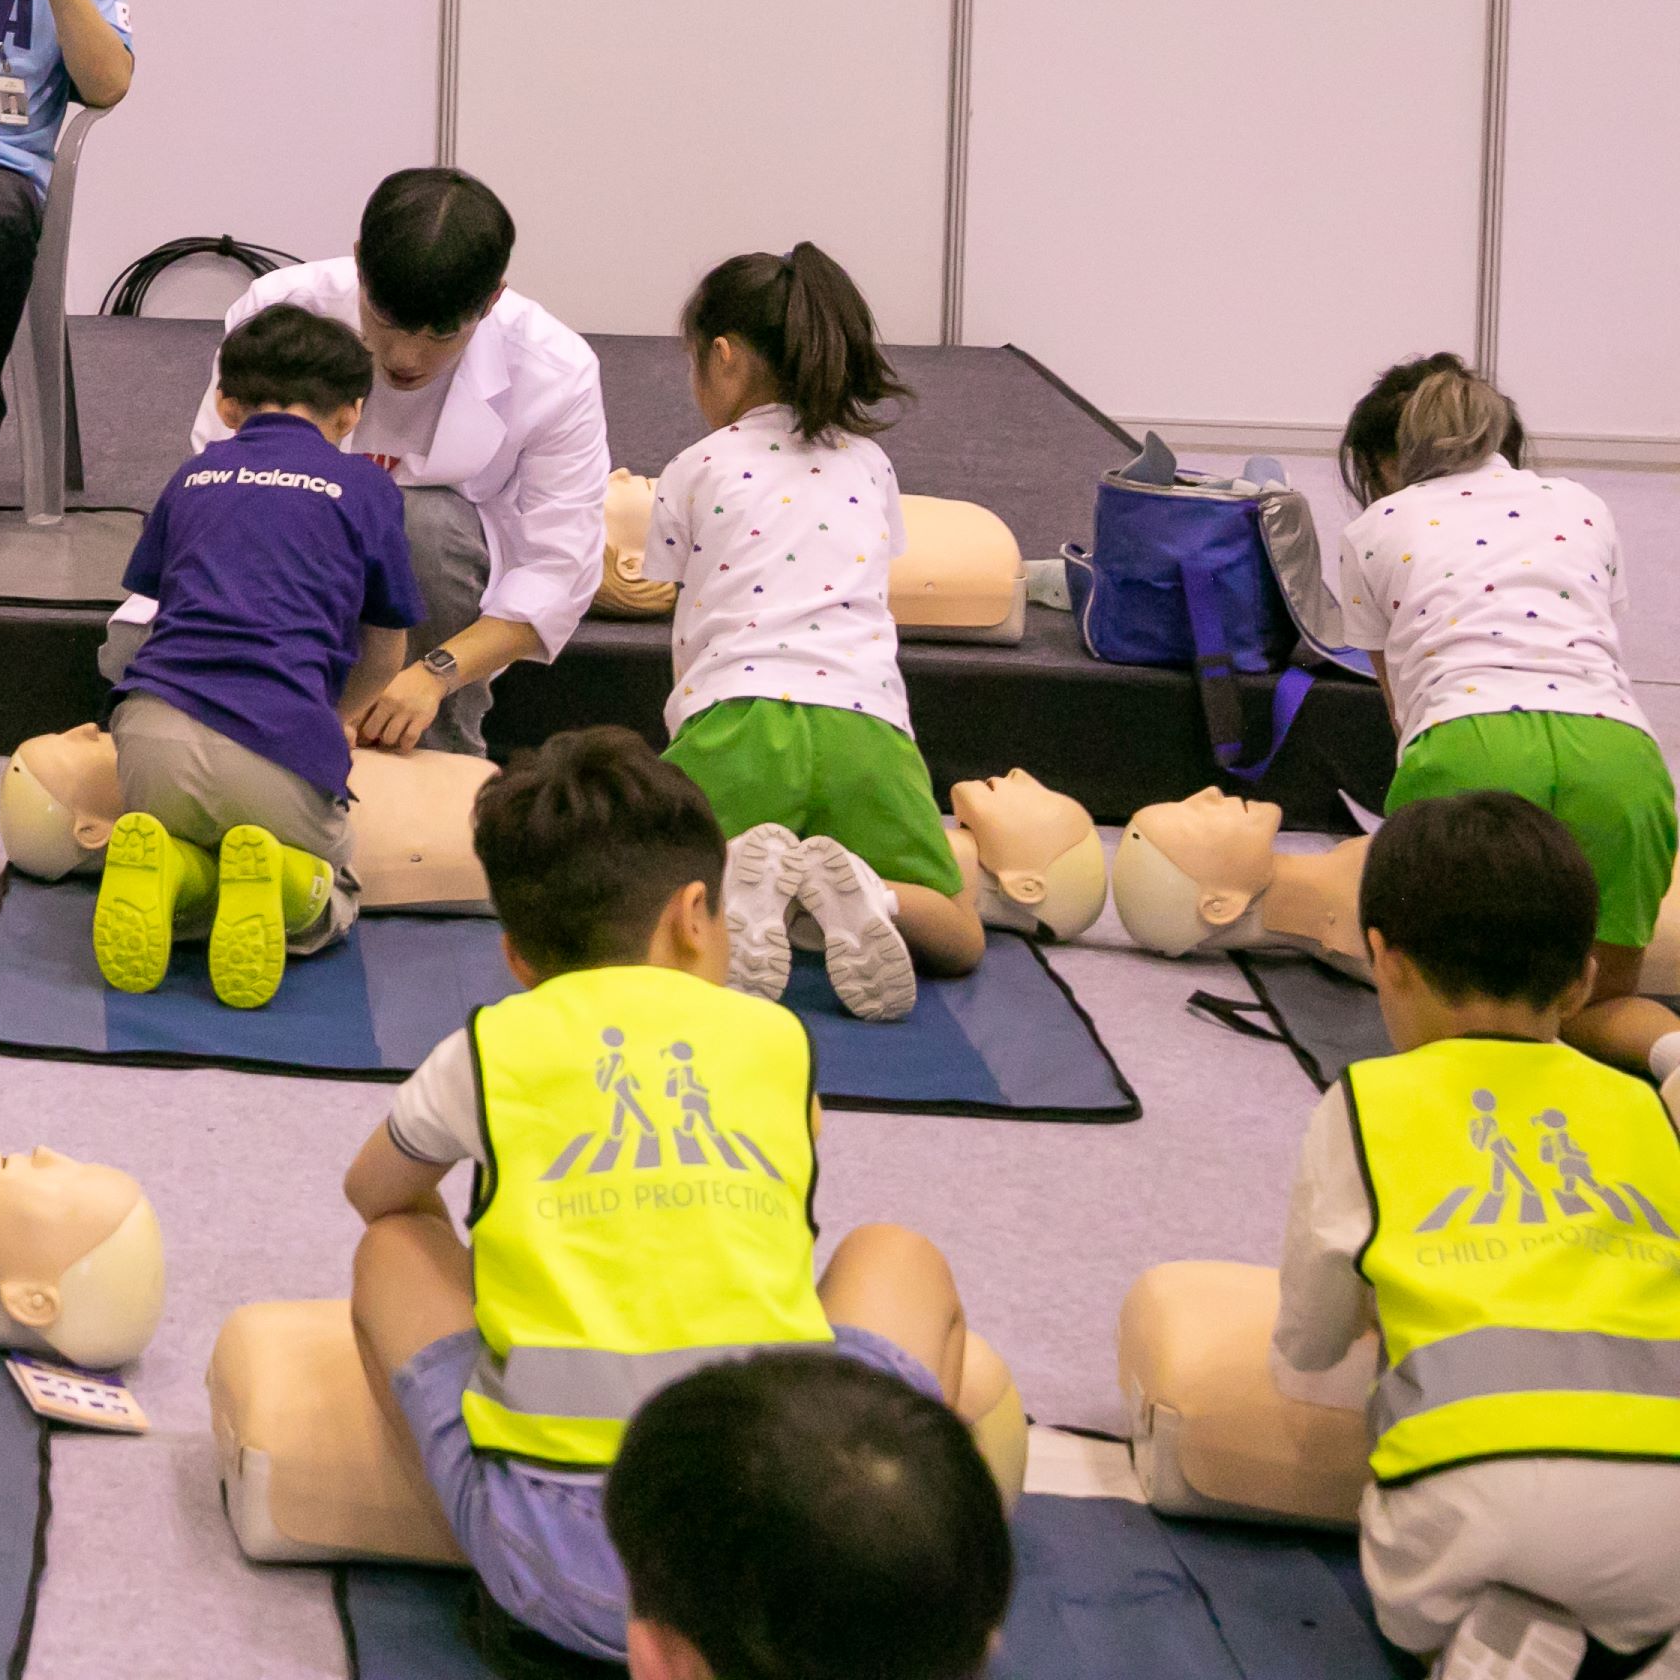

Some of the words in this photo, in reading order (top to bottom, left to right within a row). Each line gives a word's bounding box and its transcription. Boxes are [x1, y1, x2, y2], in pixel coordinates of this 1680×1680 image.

[184, 470, 234, 488] new
[237, 467, 343, 498] balance
[536, 1187, 621, 1220] CHILD
[634, 1179, 790, 1220] PROTECTION
[1416, 1237, 1508, 1267] CHILD
